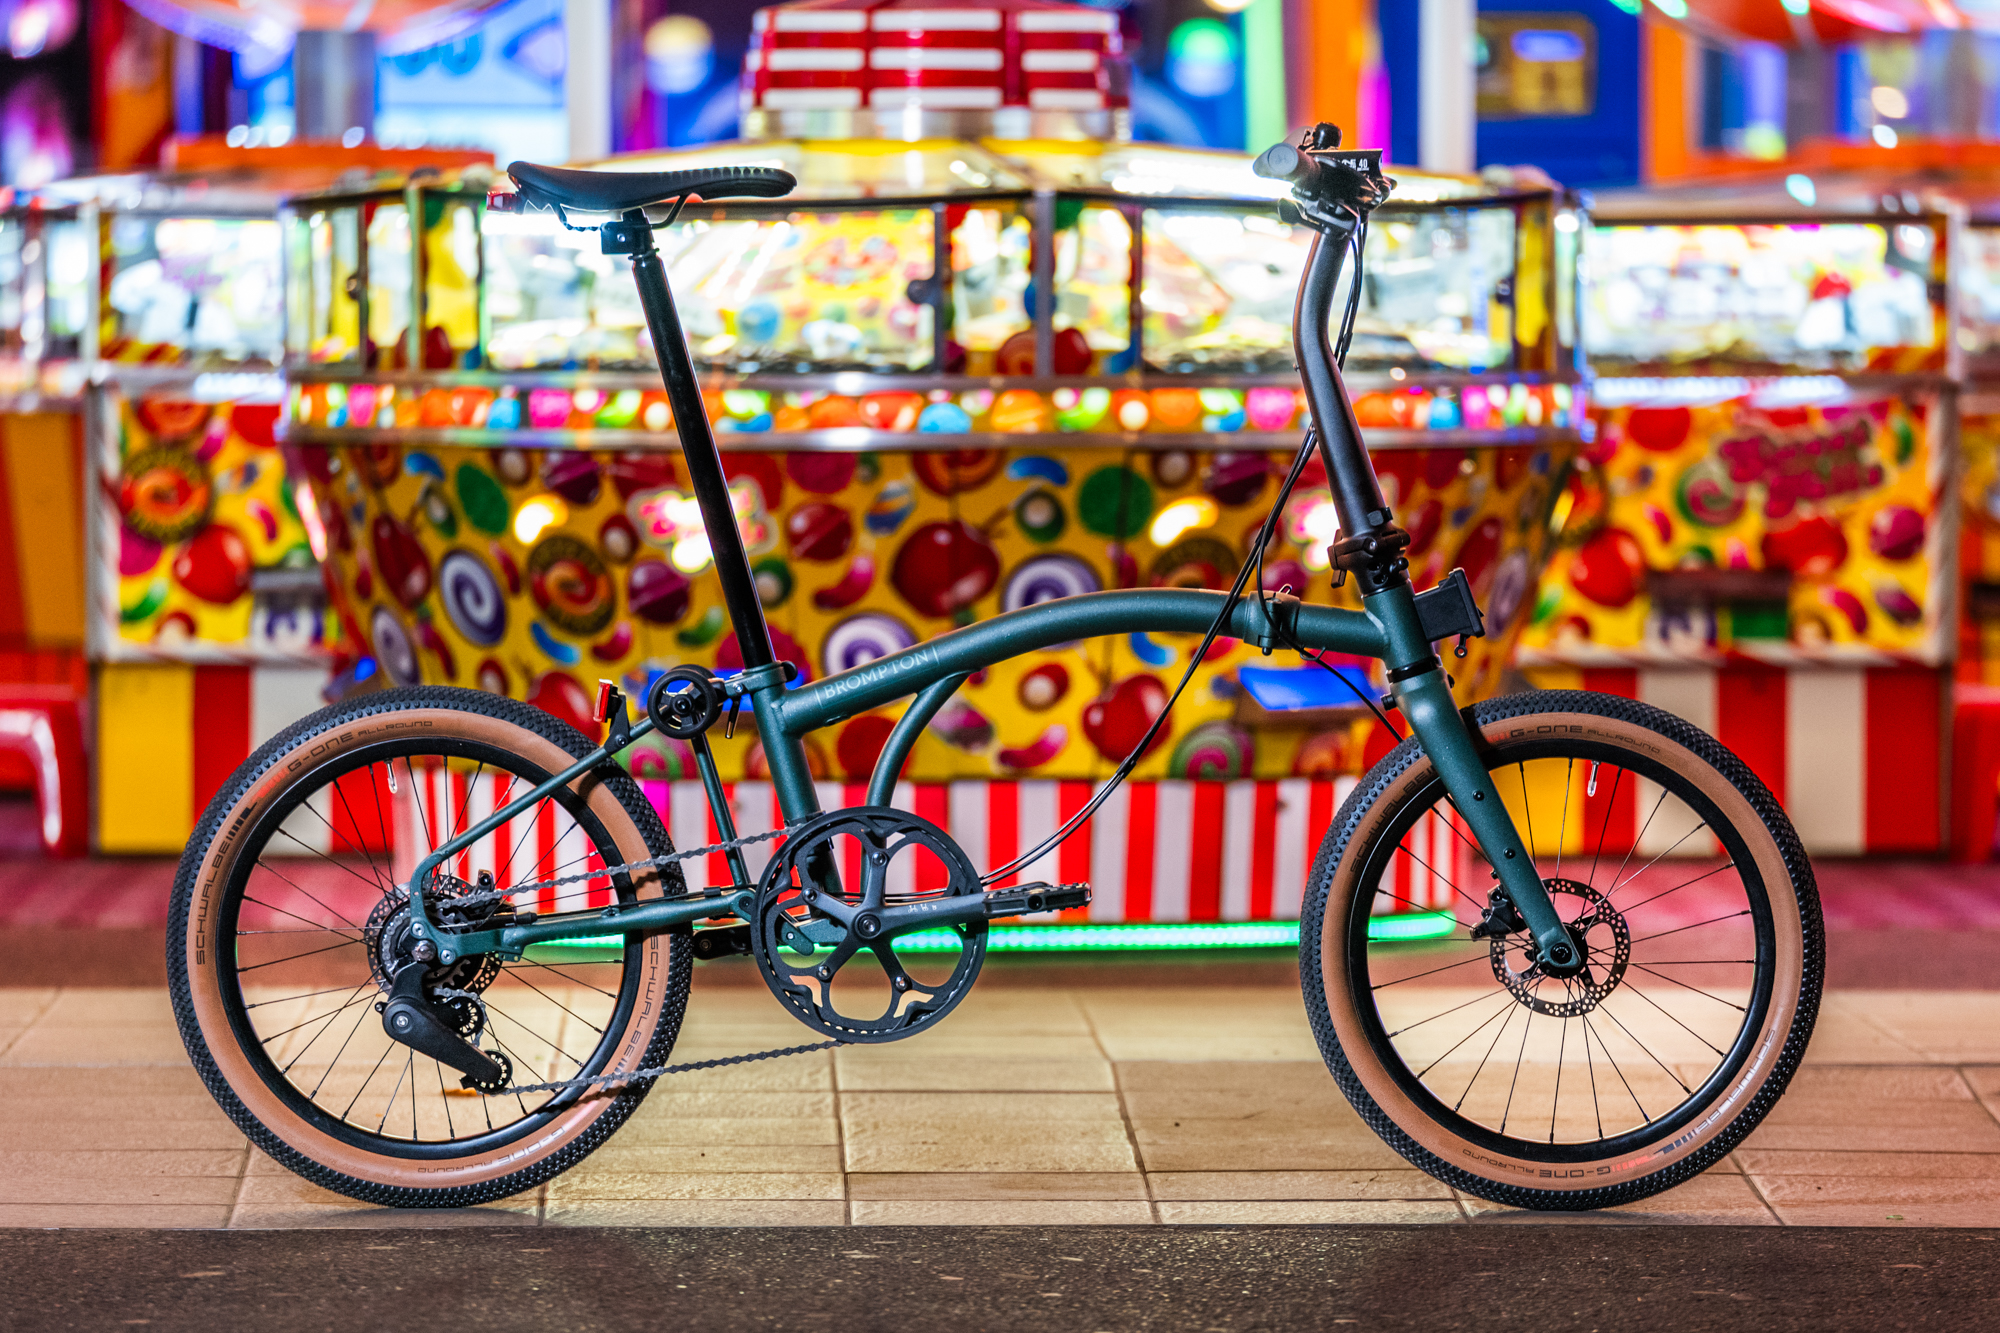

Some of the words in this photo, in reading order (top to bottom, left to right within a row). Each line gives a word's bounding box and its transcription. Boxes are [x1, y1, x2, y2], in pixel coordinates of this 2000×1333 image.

[823, 650, 929, 699] BROMPTON
[287, 731, 354, 772] G-ONE
[358, 721, 432, 737] ALLROUND
[1510, 725, 1583, 738] G-ONE
[1587, 729, 1660, 754] ALLROUND
[1350, 771, 1428, 872] SCHWALBE
[196, 840, 231, 965] SCHWALBE
[624, 936, 659, 1058] SCHWALBE
[1697, 1028, 1775, 1132] SCHWALBE
[418, 1160, 493, 1173] ALLROUND
[498, 1126, 565, 1164] G-ONE
[1462, 1148, 1534, 1174] ALLROUND
[1539, 1166, 1611, 1178] G-ONE
